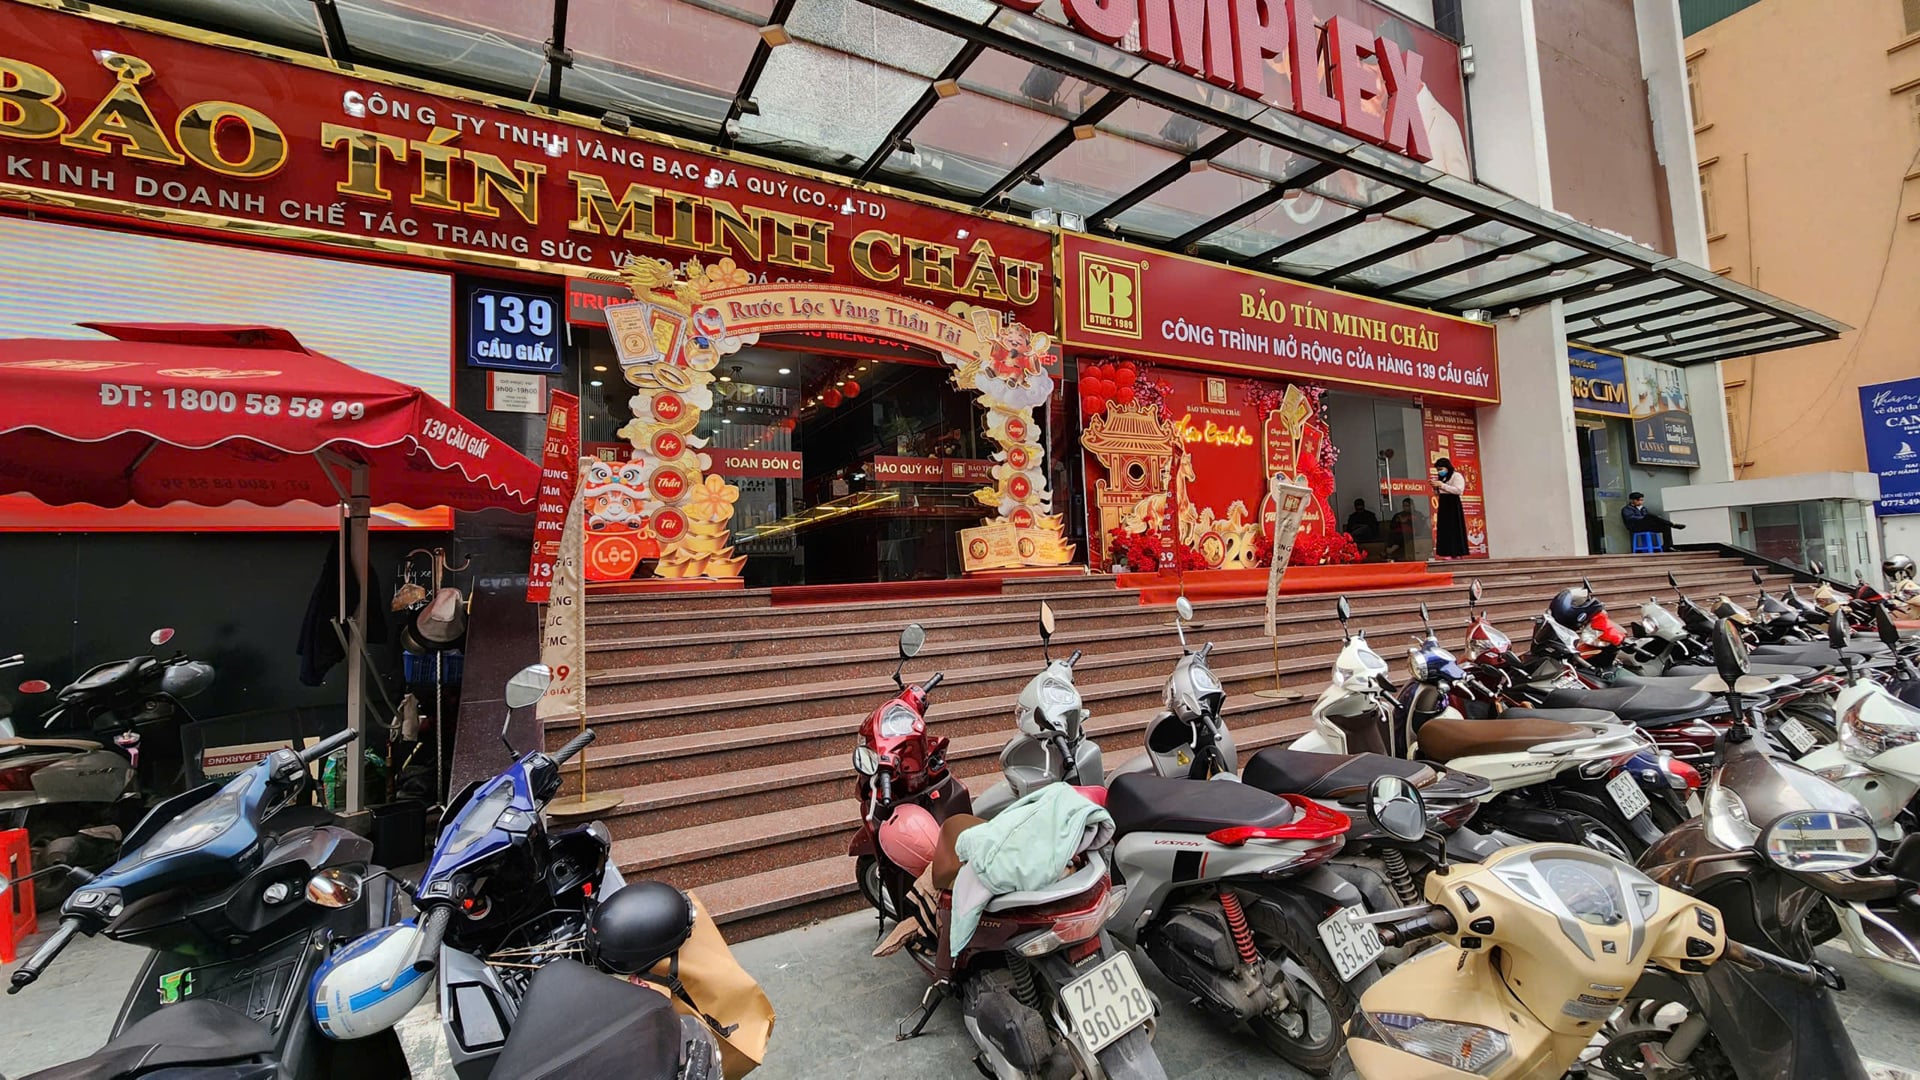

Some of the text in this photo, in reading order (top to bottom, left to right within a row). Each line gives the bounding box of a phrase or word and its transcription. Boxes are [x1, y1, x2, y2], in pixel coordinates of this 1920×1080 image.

[1005, 0, 1432, 163] MPLEX
[343, 89, 437, 126] CÔNG
[452, 113, 486, 136] TY
[494, 121, 569, 153] TNHH
[577, 138, 646, 168] VÀNG
[653, 155, 700, 180] BẠC
[707, 168, 738, 189] ĐÁ
[0, 49, 1044, 306] BẢO TÍN MINH CHÂU
[7, 155, 116, 191] KINH
[135, 175, 265, 214] DOANH
[280, 200, 346, 226] CHẾ
[360, 210, 419, 236] TÁC
[433, 222, 530, 253] TRANG
[541, 239, 593, 262] SỨC
[476, 294, 553, 336] 139
[728, 300, 784, 321] Rước
[789, 296, 825, 319] Lộc
[886, 306, 929, 334] Thần
[935, 321, 962, 345] Tài
[1089, 314, 1134, 329] BTMC 1989
[1240, 288, 1440, 352] BẢO TÍN MINH CHÂU
[476, 336, 555, 363] CẦU GIẤY
[1161, 317, 1489, 388] CÔNG TRÌNH MỞ RỘNG CỬA HÀNG 139 CẦU GIẤY
[99, 383, 365, 420] ĐT: 1800 58 58 99
[657, 401, 678, 412] Đón
[422, 418, 490, 459] 139 CẦU GIẤY
[660, 440, 677, 451] Lộc
[762, 457, 789, 469] ĐÓN
[900, 463, 922, 474] QUÝ
[1881, 498, 1920, 507] 0775.49
[599, 547, 632, 565] LỘC
[1160, 552, 1174, 561] 39
[533, 562, 553, 577] 13
[548, 636, 567, 646] MC
[550, 665, 570, 681] 39
[208, 754, 252, 765] PARKING
[1154, 839, 1202, 847] VISION
[980, 920, 1001, 928] ION
[1076, 953, 1097, 968] HONDA
[1074, 962, 1128, 1013] 27-B1
[1082, 987, 1148, 1046] 960.28
